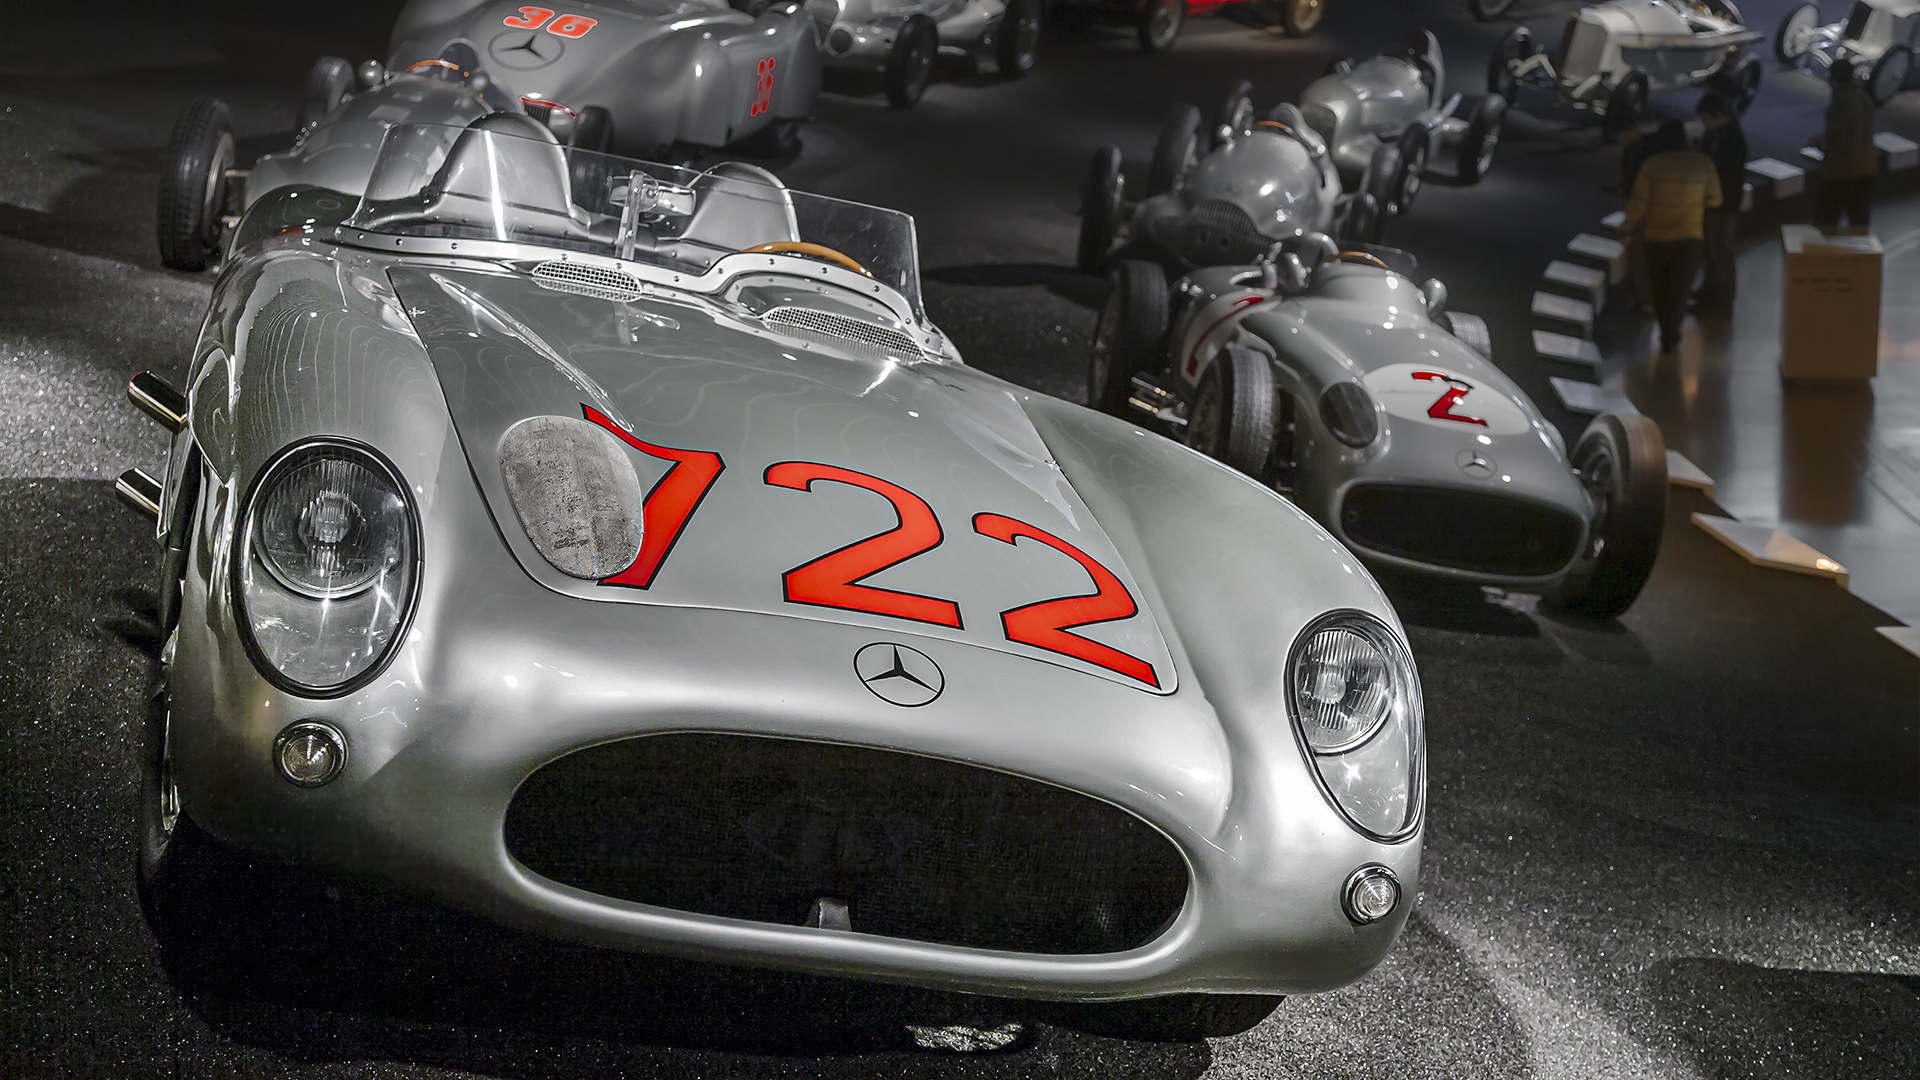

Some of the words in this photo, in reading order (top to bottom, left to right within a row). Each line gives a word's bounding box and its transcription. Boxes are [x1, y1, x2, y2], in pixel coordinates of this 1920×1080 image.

[503, 5, 598, 39] 36
[1411, 371, 1489, 428] 2
[580, 402, 1161, 690] 722
